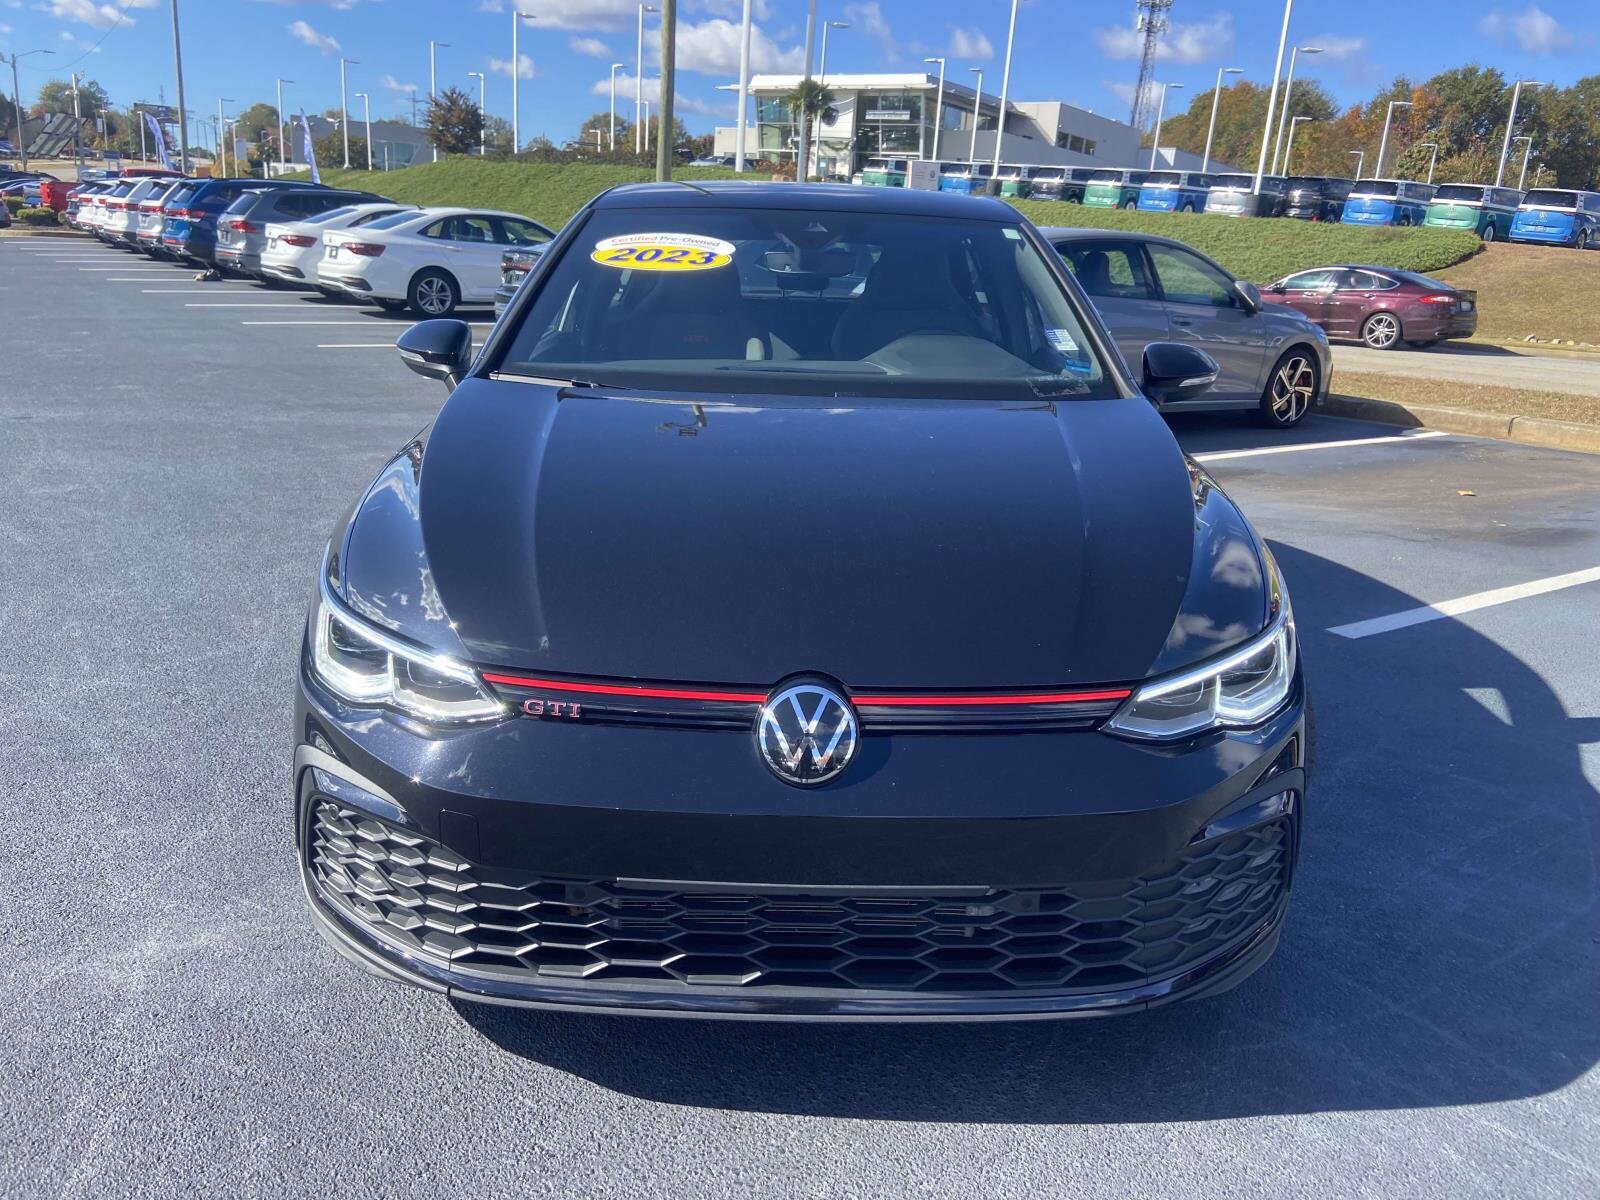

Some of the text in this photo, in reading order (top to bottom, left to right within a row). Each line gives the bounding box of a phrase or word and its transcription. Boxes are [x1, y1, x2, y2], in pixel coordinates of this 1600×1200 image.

[611, 235, 657, 243] Certified
[659, 235, 720, 247] Pre-Owned
[604, 248, 718, 265] 2023
[524, 699, 580, 718] GTI
